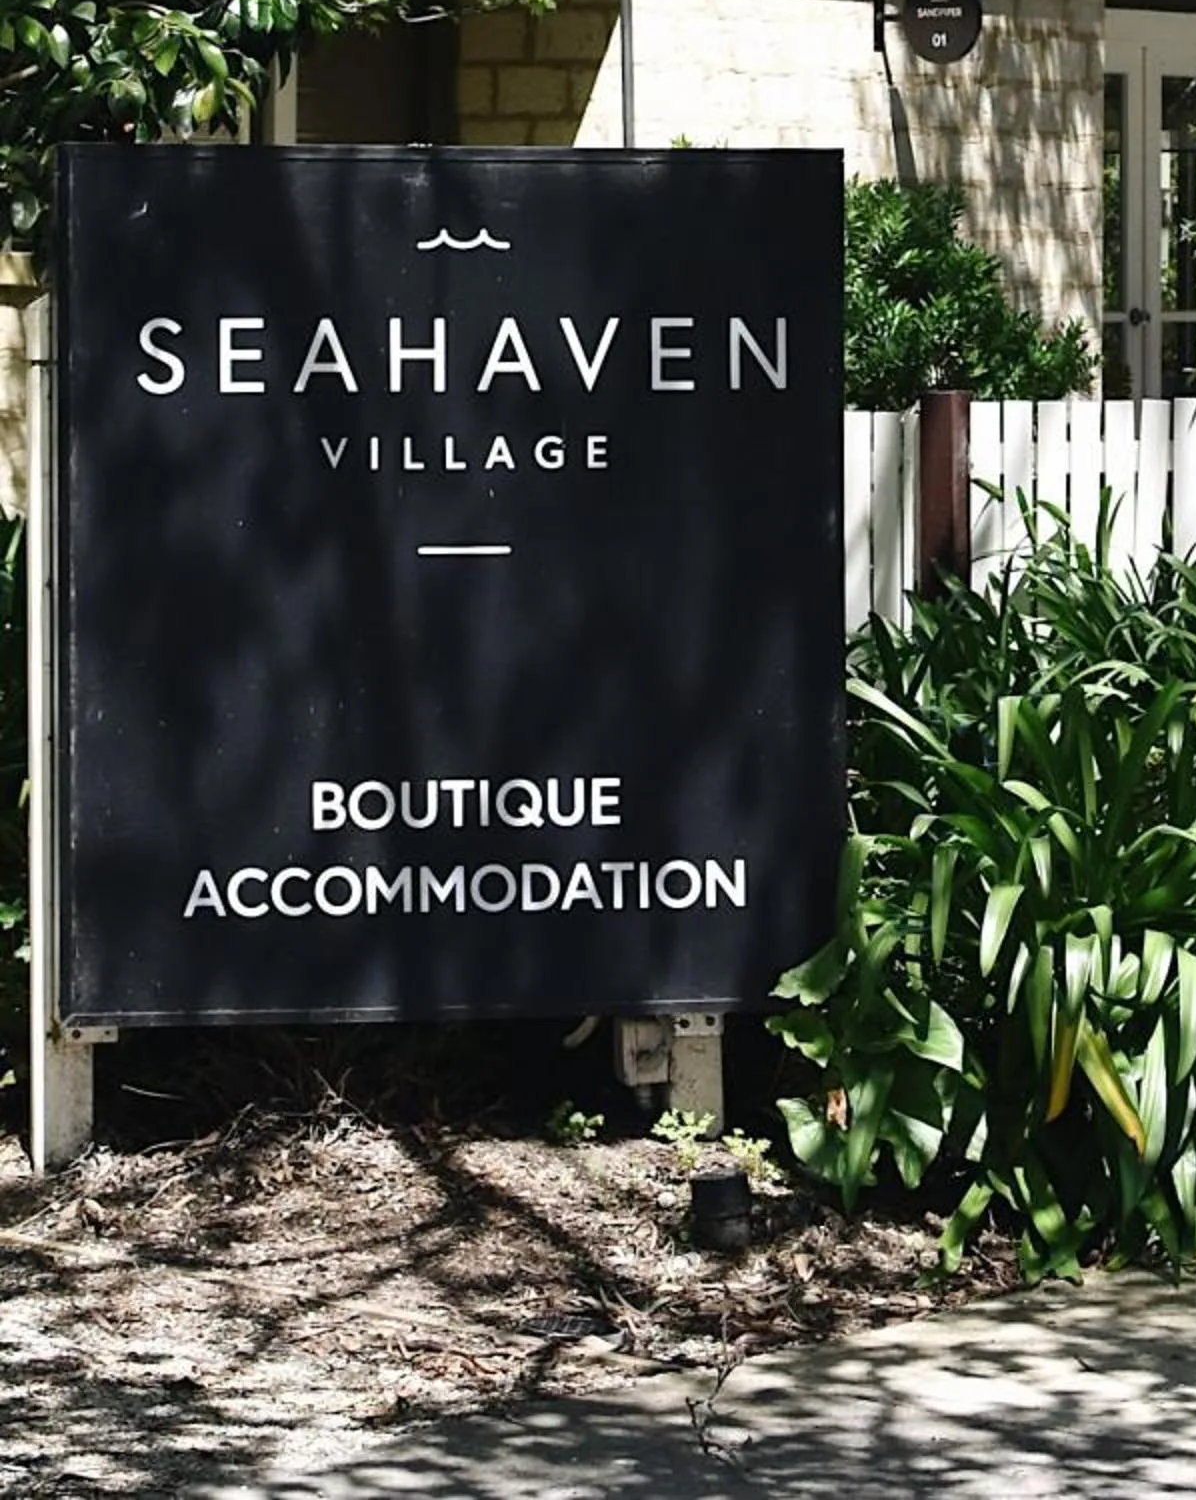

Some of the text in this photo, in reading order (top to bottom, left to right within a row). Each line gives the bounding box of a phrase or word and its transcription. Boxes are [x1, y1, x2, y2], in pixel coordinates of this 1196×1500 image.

[931, 33, 947, 48] 01
[137, 318, 786, 394] SEAHAVEN
[322, 436, 607, 470] VILLAGE
[313, 778, 620, 830] BOUTIQUE
[184, 860, 745, 917] ACCOMMODATION
